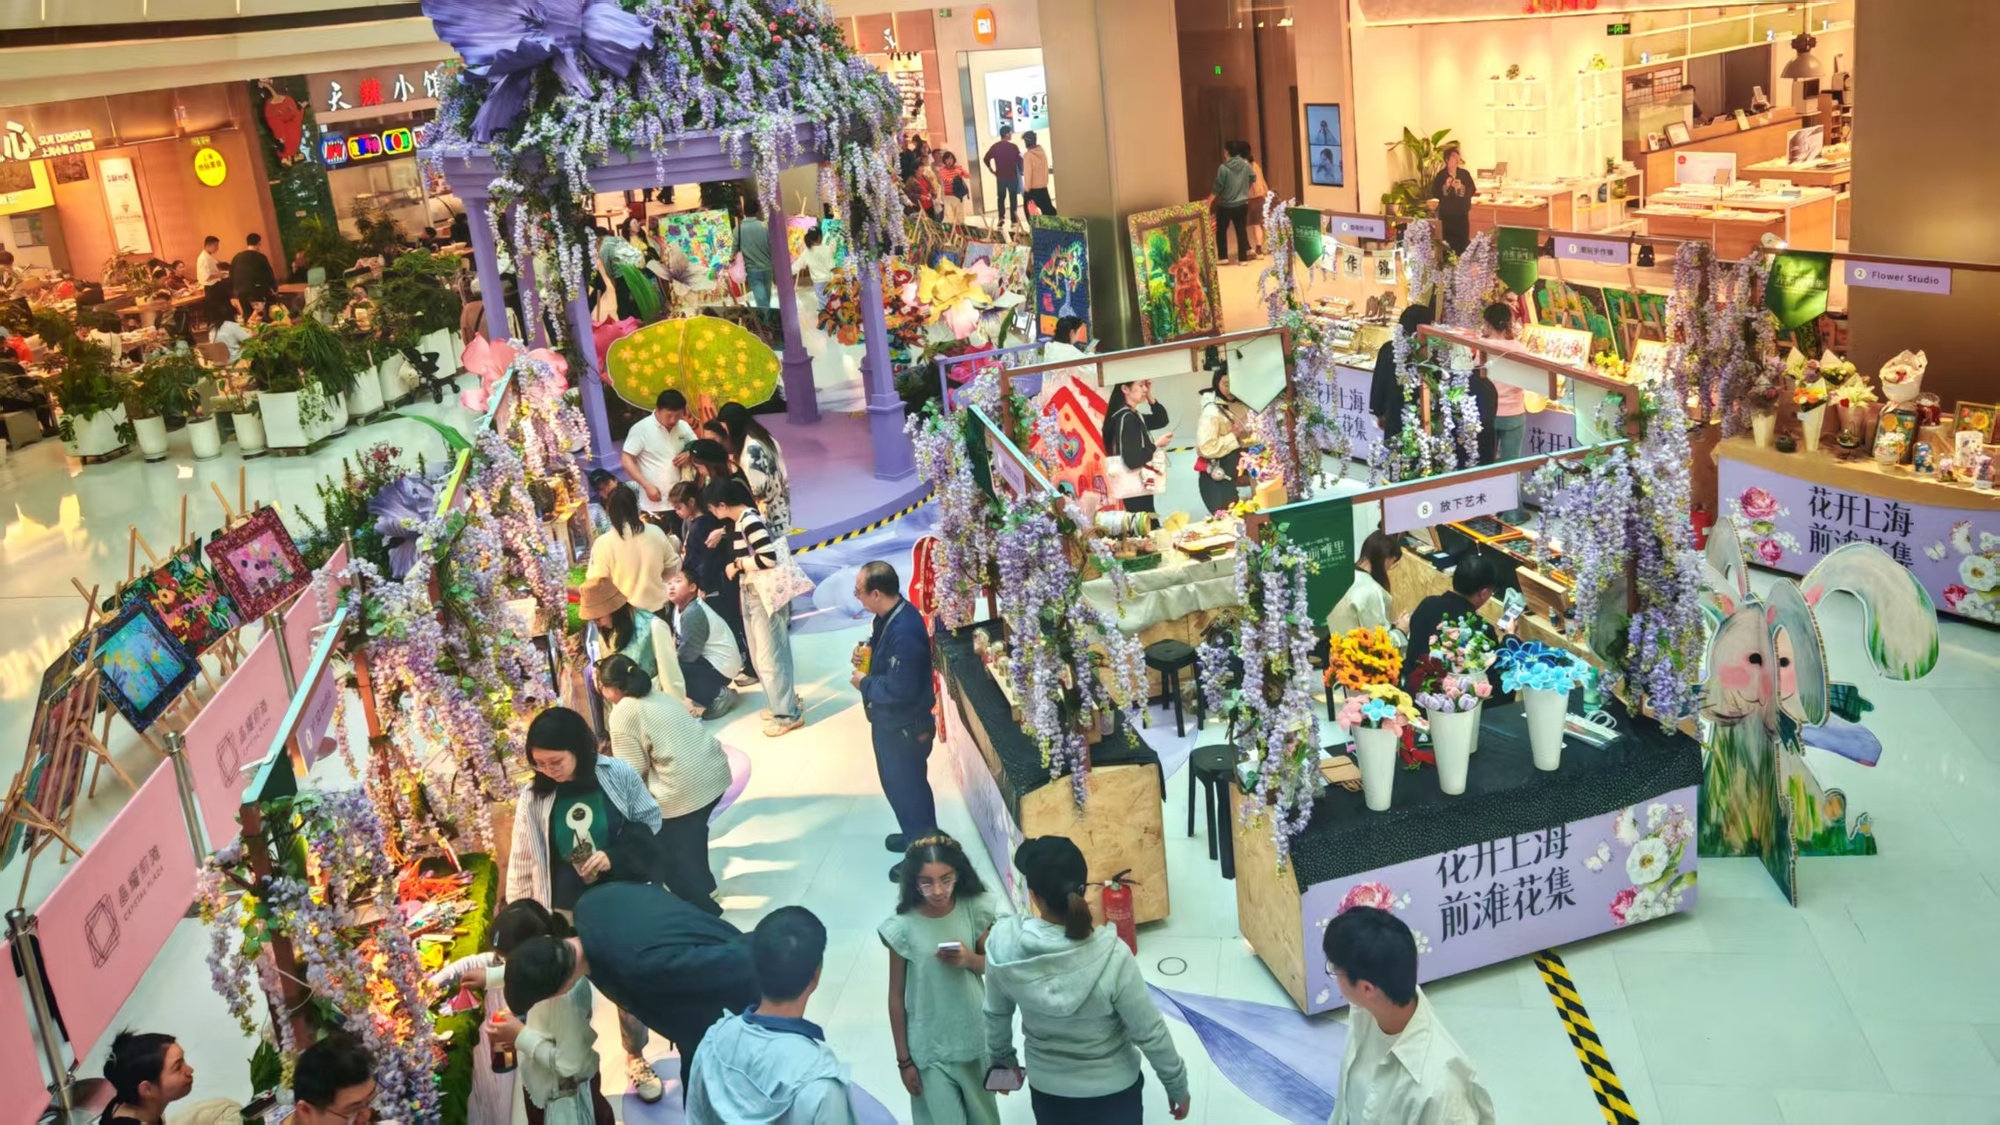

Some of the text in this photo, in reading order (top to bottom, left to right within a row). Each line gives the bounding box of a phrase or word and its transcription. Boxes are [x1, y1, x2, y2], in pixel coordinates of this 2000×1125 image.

[1872, 271, 1904, 283] Flower
[1907, 274, 1940, 285] Studio
[1422, 493, 1487, 515] 8 放下艺术
[1808, 486, 1914, 538] 花开上海
[1809, 522, 1915, 569] 前集
[1438, 866, 1577, 943] 前滩花集
